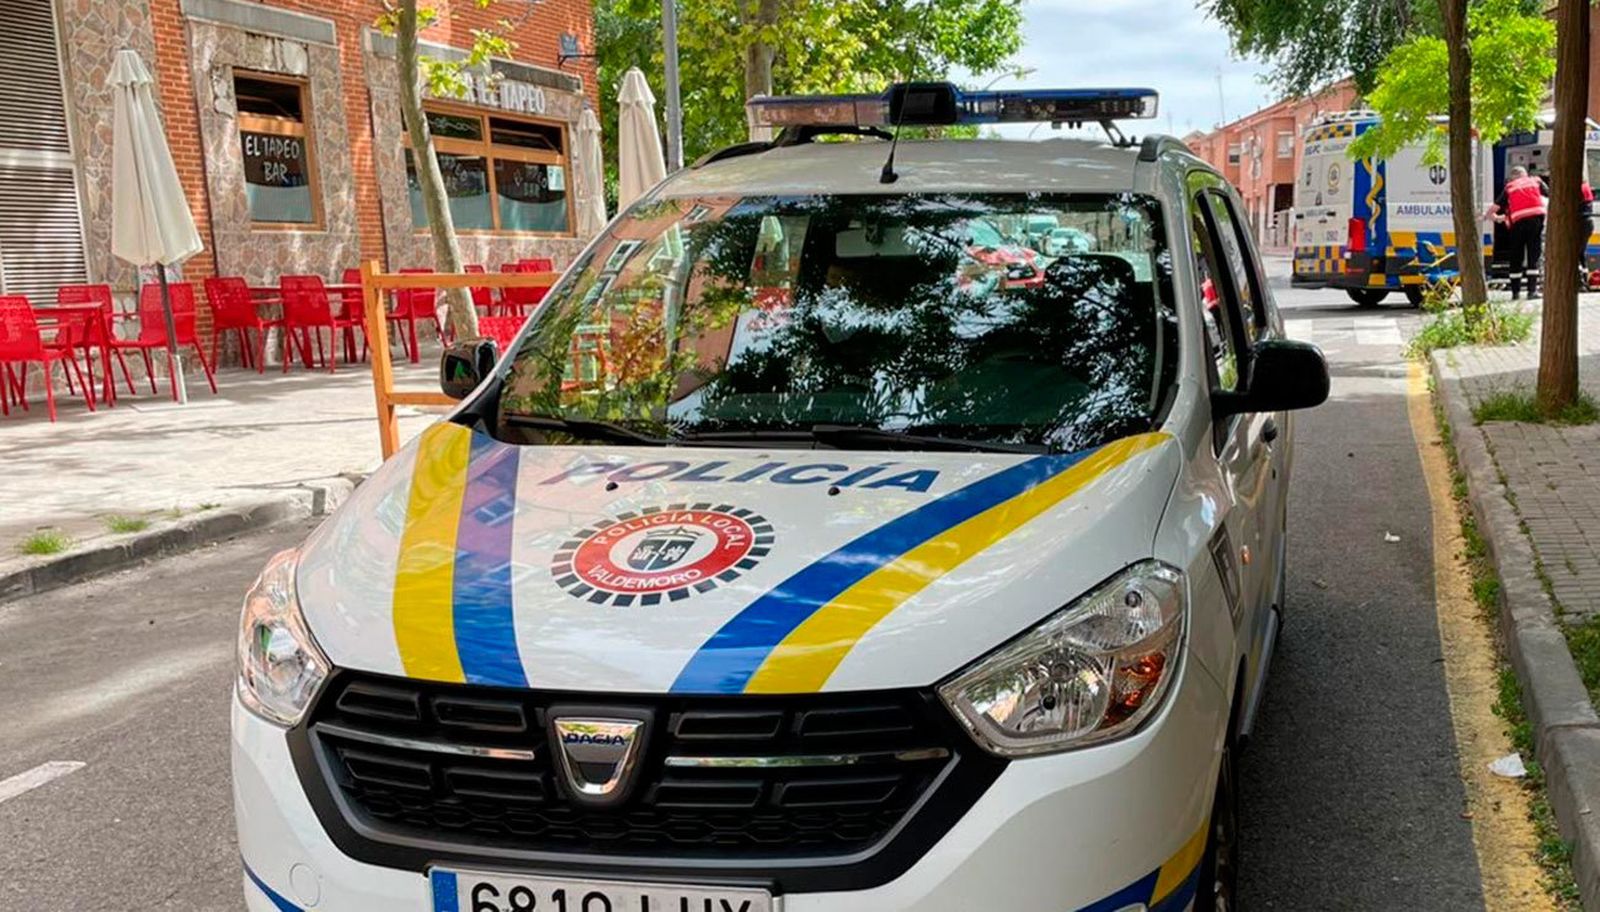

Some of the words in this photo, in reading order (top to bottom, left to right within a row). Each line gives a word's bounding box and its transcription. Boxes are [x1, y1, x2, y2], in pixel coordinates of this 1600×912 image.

[500, 80, 546, 114] TAPEO
[245, 135, 261, 157] EL
[262, 137, 300, 159] TAPEO
[263, 161, 289, 183] BAR
[1396, 203, 1455, 215] AMBULAN
[538, 461, 940, 494] POLICÍA
[592, 512, 693, 545] POLICÍA
[701, 514, 748, 550] LOCAL
[589, 564, 702, 589] VALDEMORO
[565, 732, 625, 746] DACIA
